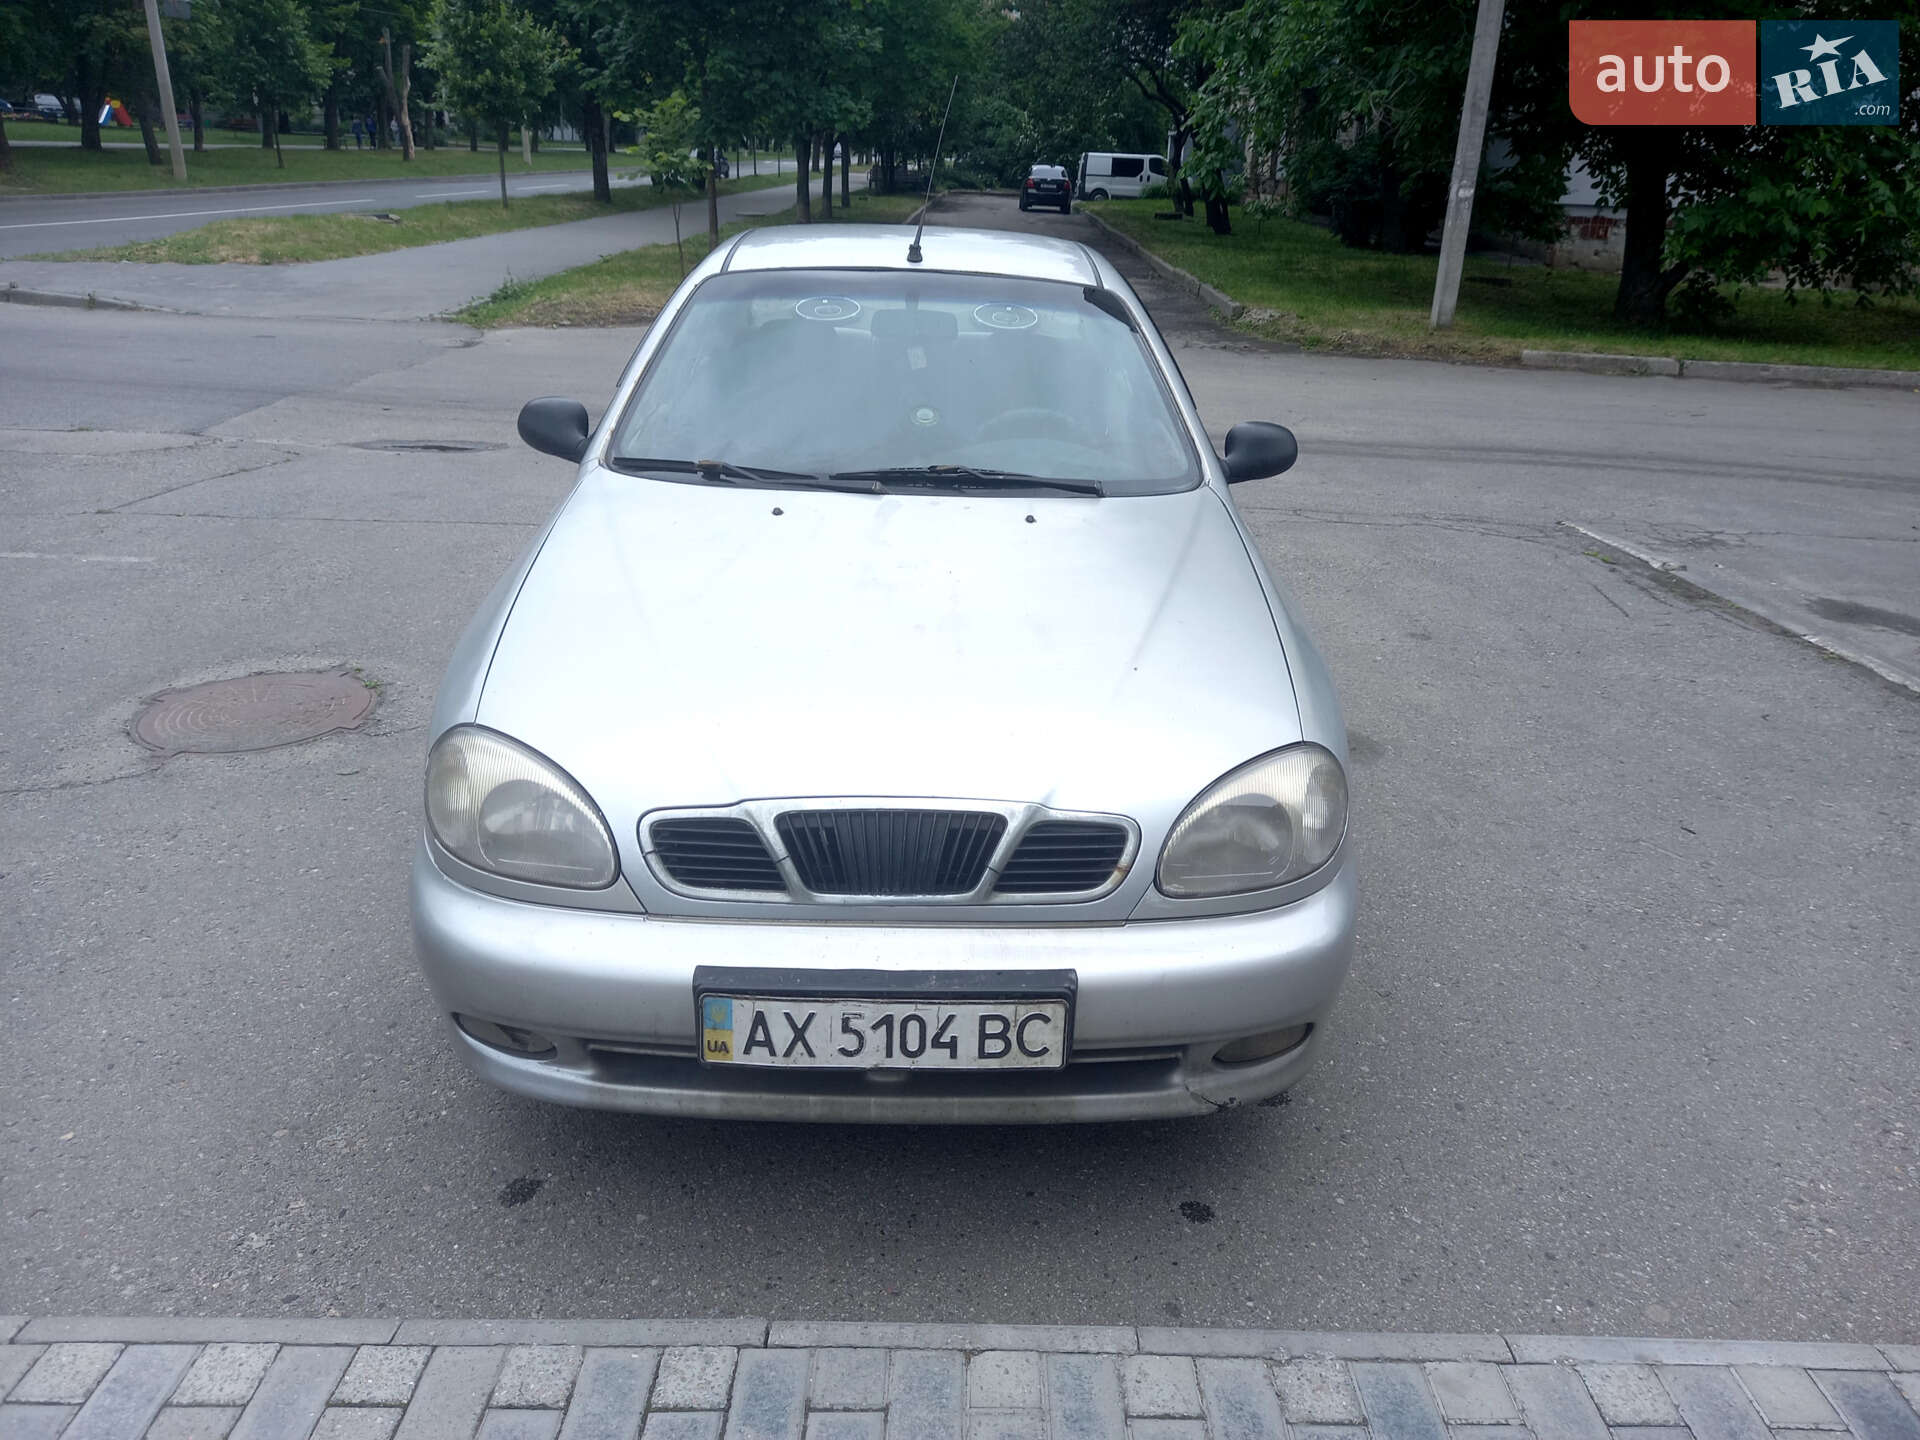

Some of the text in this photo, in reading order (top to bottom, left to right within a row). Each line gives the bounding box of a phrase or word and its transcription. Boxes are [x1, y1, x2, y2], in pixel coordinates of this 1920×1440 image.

[706, 1040, 729, 1054] UA
[742, 1010, 1052, 1059] AX 5104 BC
